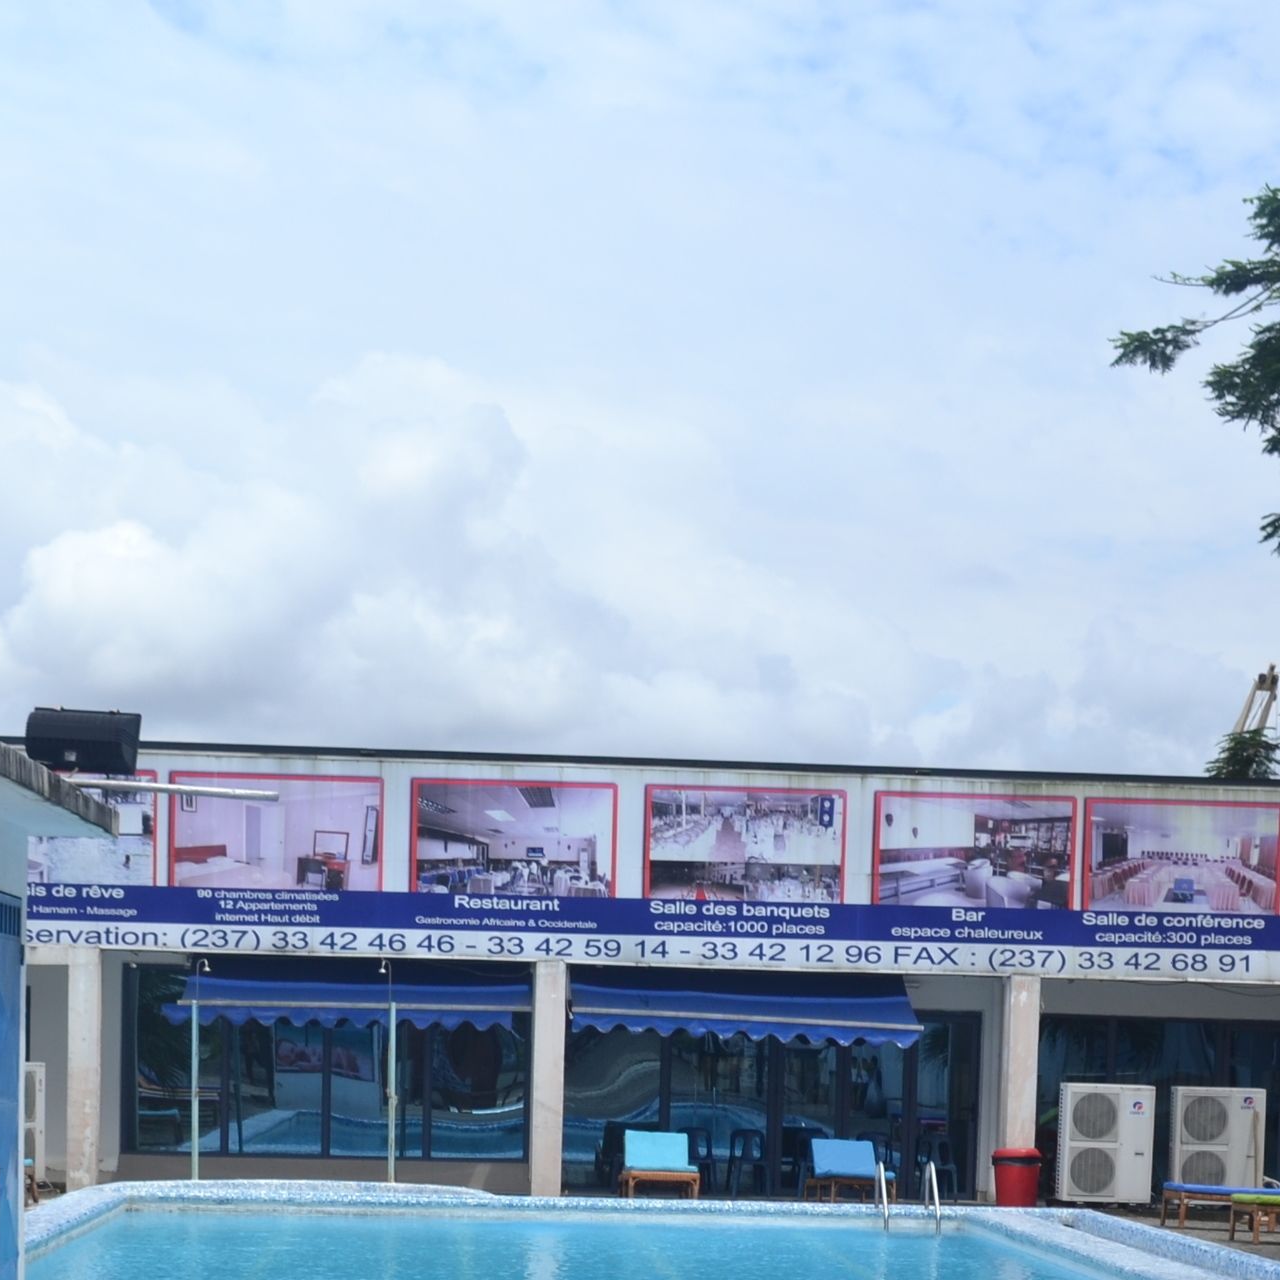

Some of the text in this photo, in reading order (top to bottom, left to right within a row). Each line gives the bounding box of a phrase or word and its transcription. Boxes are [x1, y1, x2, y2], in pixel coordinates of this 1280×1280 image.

[51, 884, 76, 897] de
[82, 883, 125, 899] rêve
[196, 888, 339, 901] 90 chambres climatisées
[219, 900, 318, 912] 12 Appartements
[454, 894, 560, 911] Restaurant
[649, 900, 830, 920] Salle des banquets
[33, 904, 78, 915] Hamam
[86, 906, 137, 917] Massage
[215, 912, 320, 924] internet Haut débit
[951, 907, 986, 922] Bar
[415, 915, 597, 929] Gastronomie Africaine & Occidentale
[654, 919, 825, 936] capacité:1000 places
[1082, 911, 1265, 929] Salle de conférence
[891, 925, 1044, 940] espace chaleureux
[1095, 930, 1252, 947] capacité:300 places
[180, 928, 260, 951] (237)
[272, 930, 309, 949] 33
[320, 931, 357, 951] 42
[368, 932, 407, 952] 46
[416, 934, 455, 953] 46
[487, 936, 525, 955] 33
[535, 938, 572, 956] 42
[584, 939, 622, 958] 59
[634, 940, 669, 959] 14
[701, 941, 738, 960] 33
[748, 942, 786, 962] 42
[800, 944, 834, 963] 12
[845, 945, 882, 964] 96
[894, 946, 959, 966] FAX
[989, 948, 1066, 973] (237)
[1078, 951, 1114, 970] 33
[1124, 952, 1161, 971] 42
[1171, 953, 1208, 972] 68
[1219, 954, 1251, 973] 91
